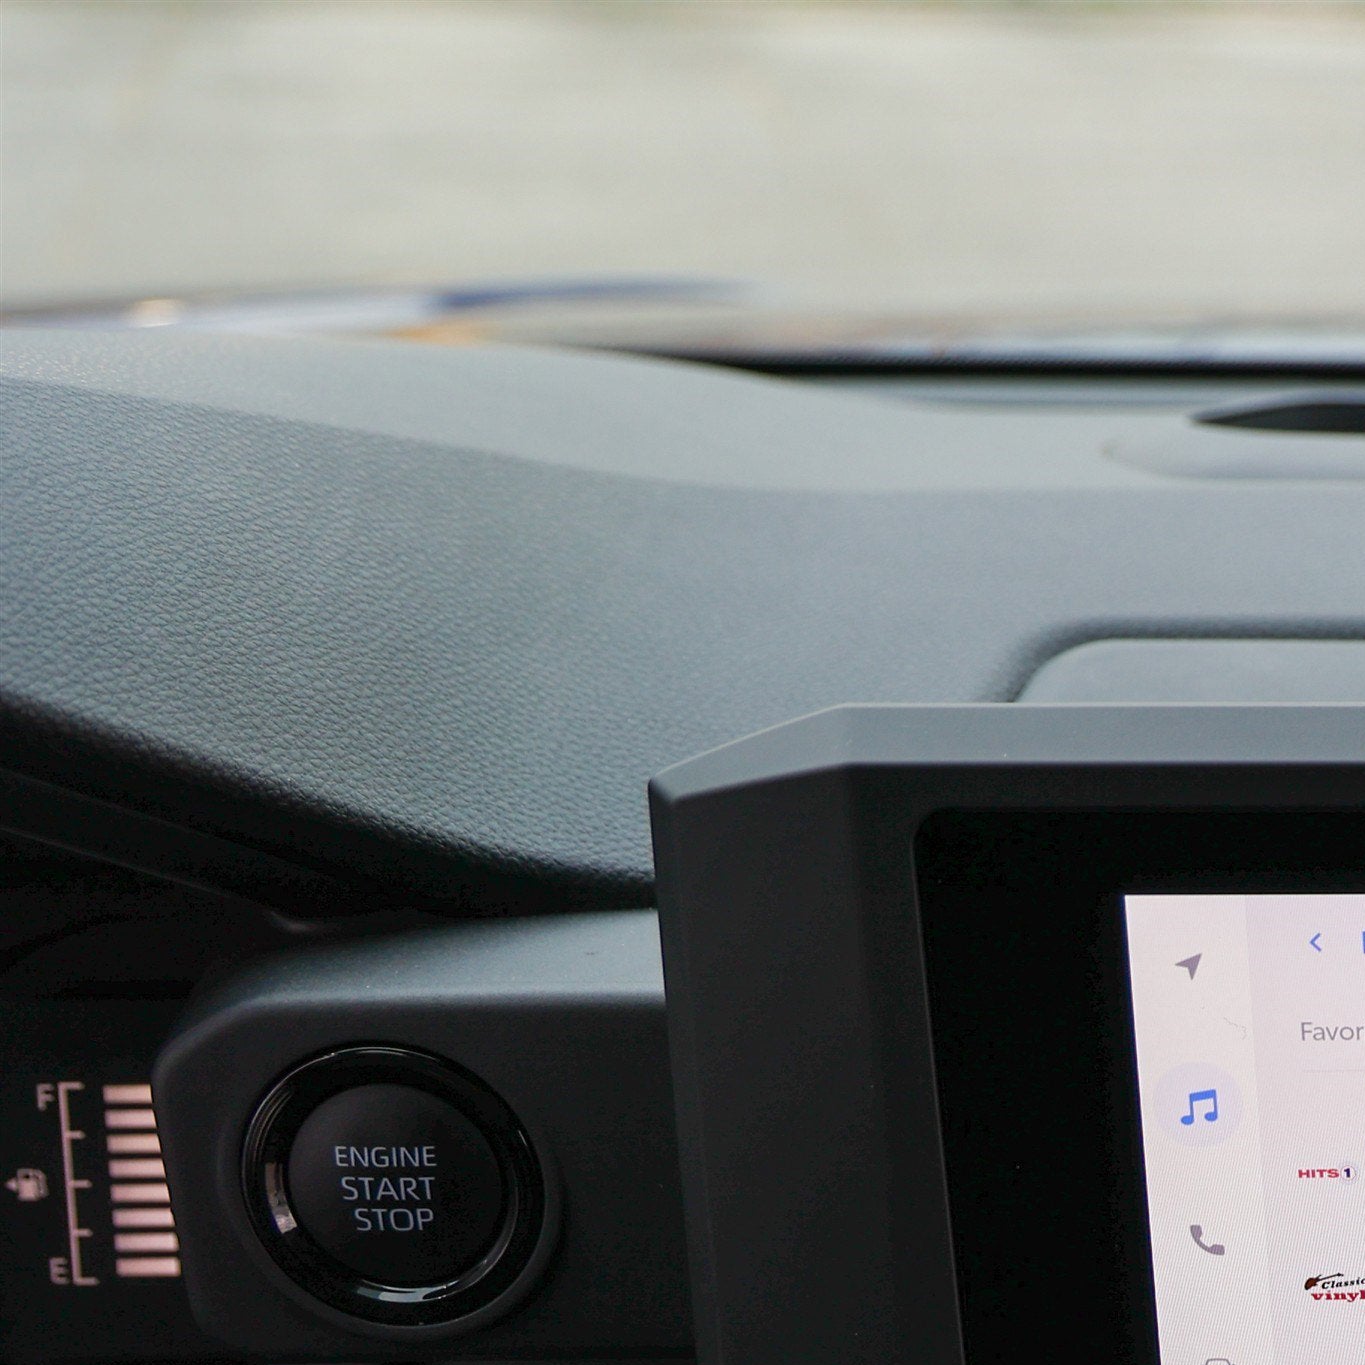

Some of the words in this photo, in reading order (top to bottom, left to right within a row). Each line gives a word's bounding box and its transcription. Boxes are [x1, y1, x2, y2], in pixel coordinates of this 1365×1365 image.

[36, 1084, 57, 1111] F
[334, 1146, 437, 1168] ENGINE
[1298, 1168, 1340, 1179] HITS
[341, 1176, 436, 1201] START
[354, 1208, 434, 1232] STOP
[49, 1258, 70, 1285] E
